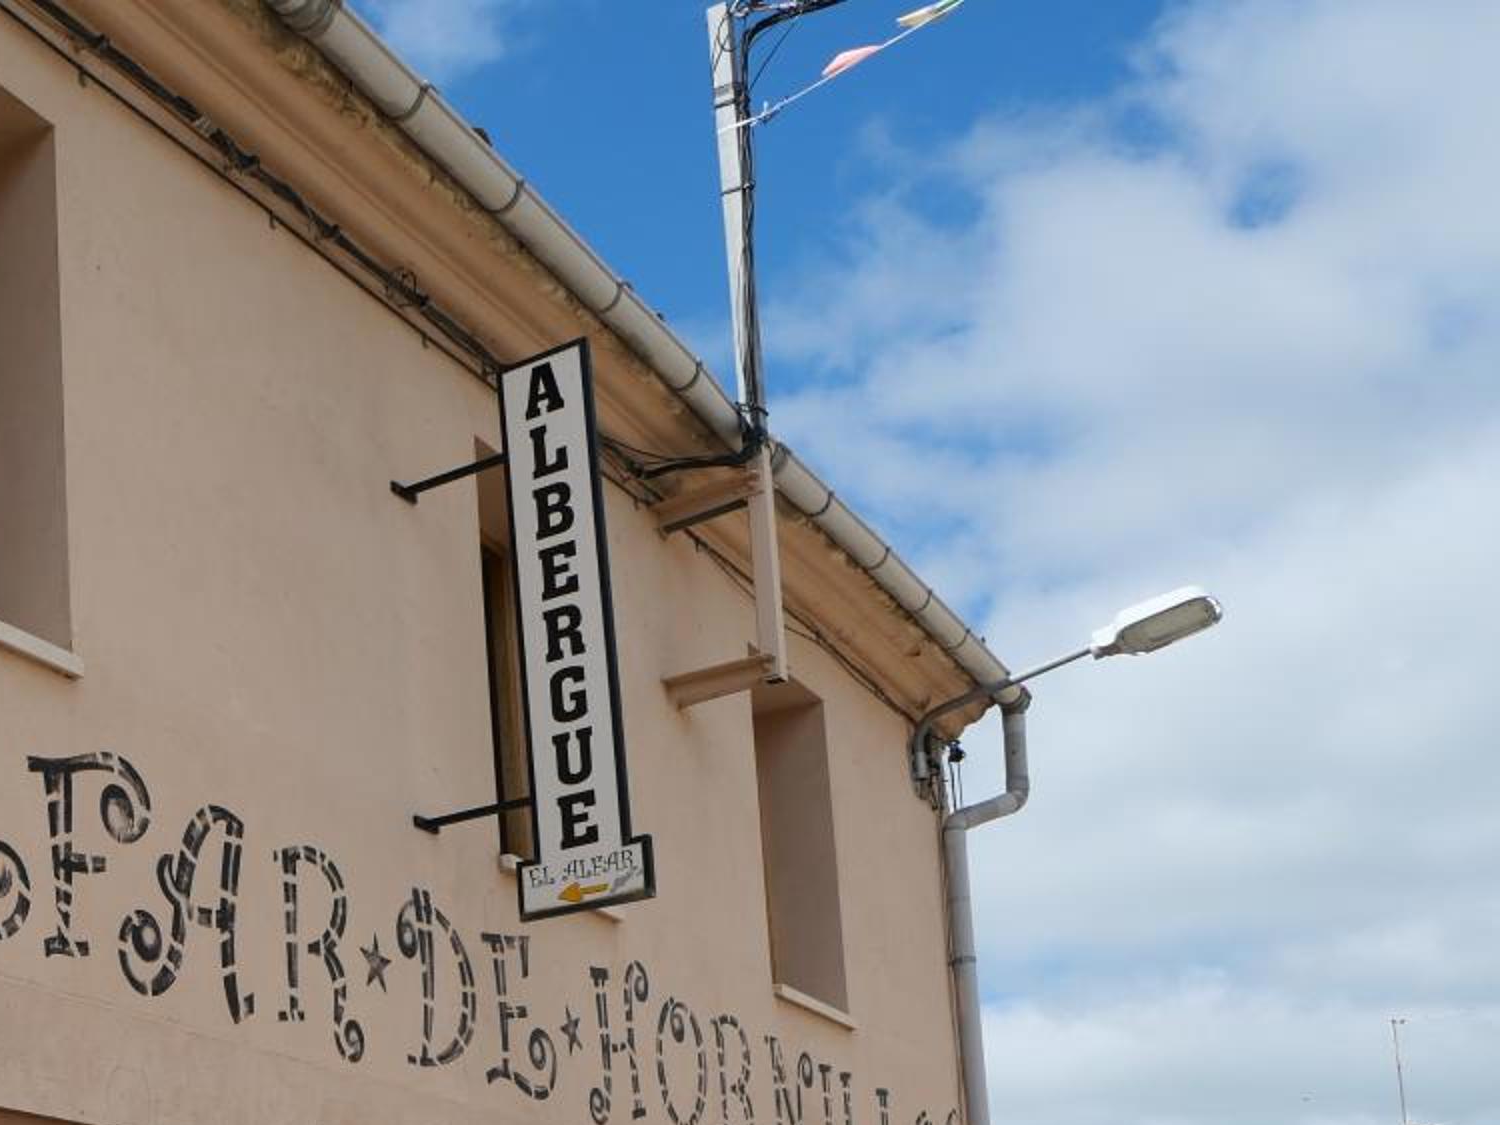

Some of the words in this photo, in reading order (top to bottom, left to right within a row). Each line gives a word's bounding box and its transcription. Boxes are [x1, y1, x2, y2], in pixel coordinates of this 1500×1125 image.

[525, 361, 599, 850] ALBERGUE
[529, 866, 555, 888] EL
[562, 849, 636, 881] ALFAR
[396, 887, 558, 1101] DE
